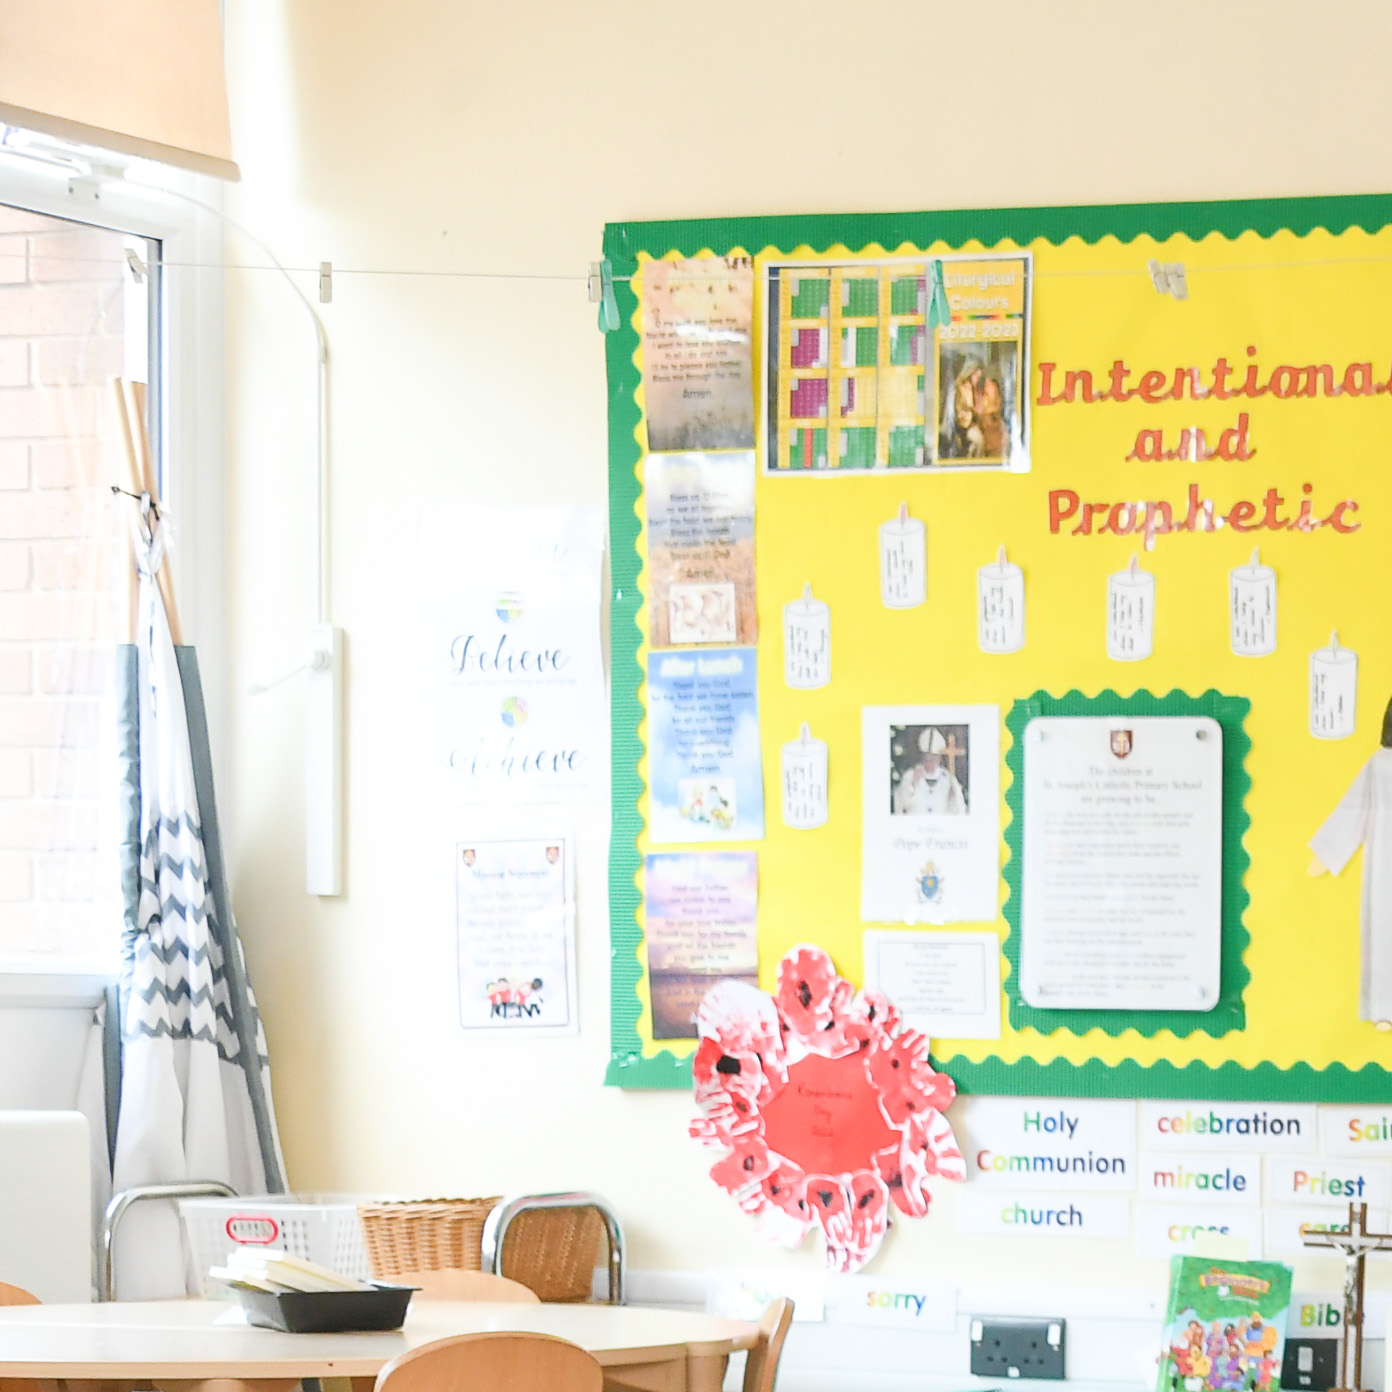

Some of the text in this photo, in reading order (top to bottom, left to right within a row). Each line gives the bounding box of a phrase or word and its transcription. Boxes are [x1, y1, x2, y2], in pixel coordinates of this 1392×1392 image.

[951, 294, 1009, 310] Colours
[1125, 413, 1257, 463] and
[1048, 483, 1361, 552] Prophetic
[450, 633, 570, 675] Believe
[1022, 1111, 1080, 1140] Holy
[1156, 1110, 1302, 1136] celebration
[976, 1149, 1126, 1176] Communion
[1153, 1168, 1246, 1192] miracle
[1293, 1169, 1366, 1199] Priest
[1001, 1203, 1083, 1228] church
[866, 1291, 928, 1317] sorry
[1299, 1303, 1342, 1327] Bib
